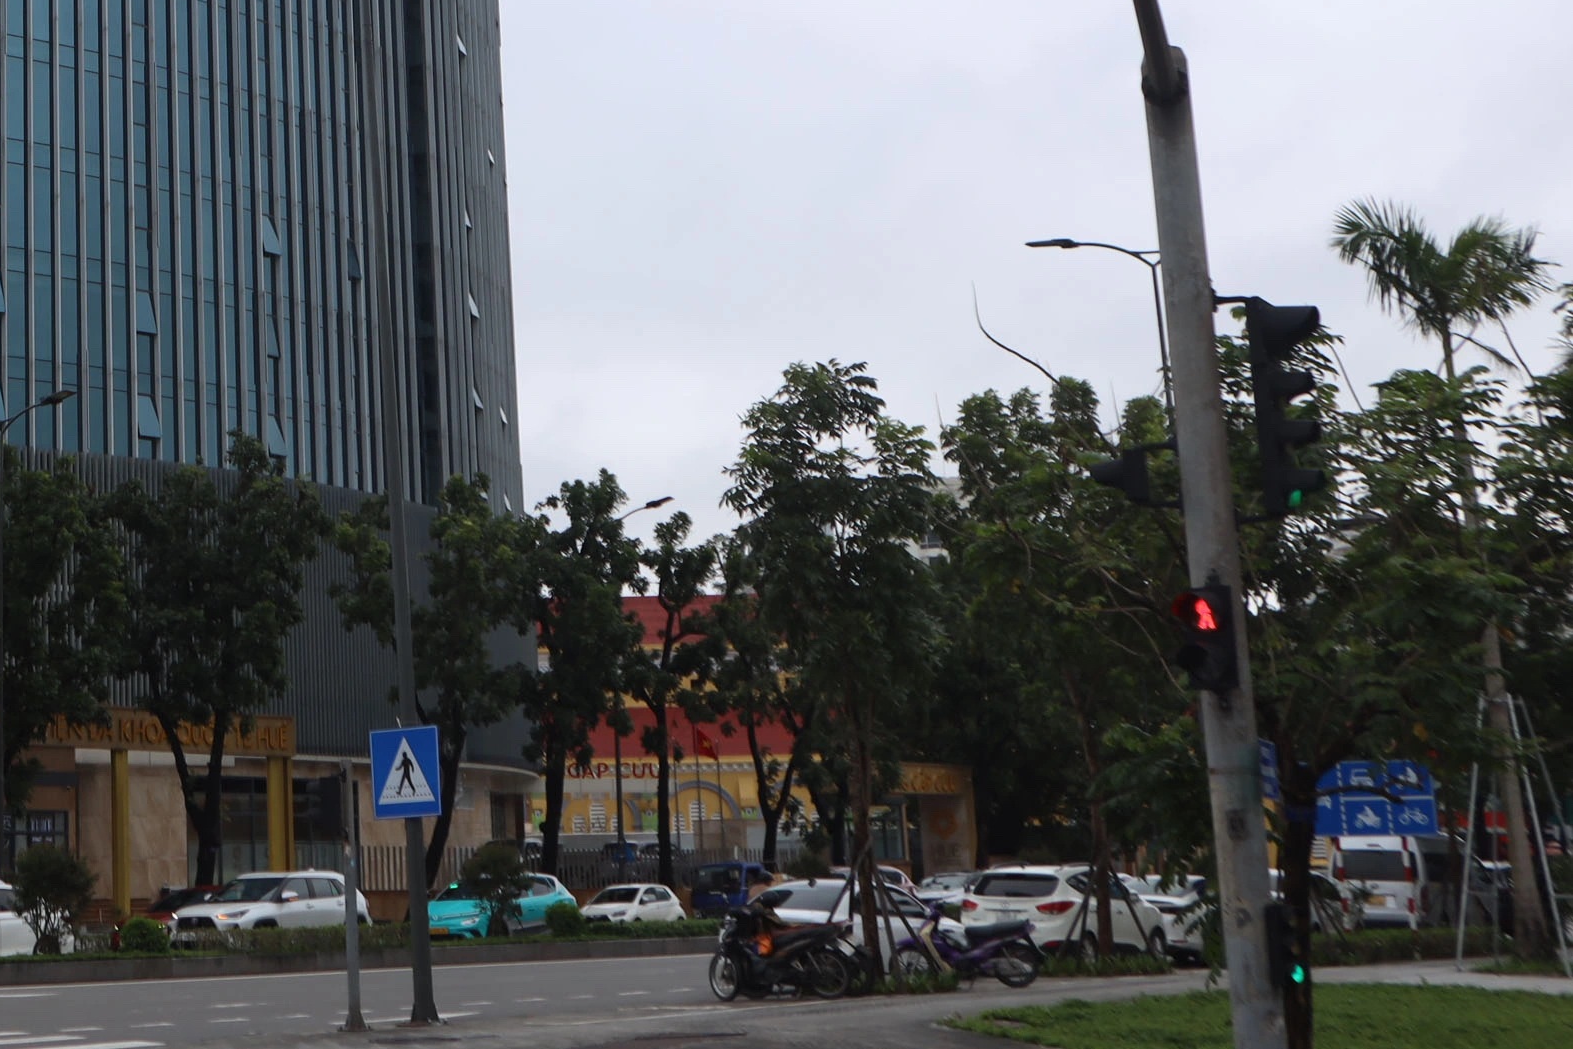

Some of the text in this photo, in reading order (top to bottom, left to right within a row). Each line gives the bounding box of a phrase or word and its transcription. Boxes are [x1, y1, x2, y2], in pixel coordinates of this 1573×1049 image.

[118, 718, 169, 745] KHOA
[177, 718, 218, 747] QUỐ
[256, 719, 289, 751] HUẾ
